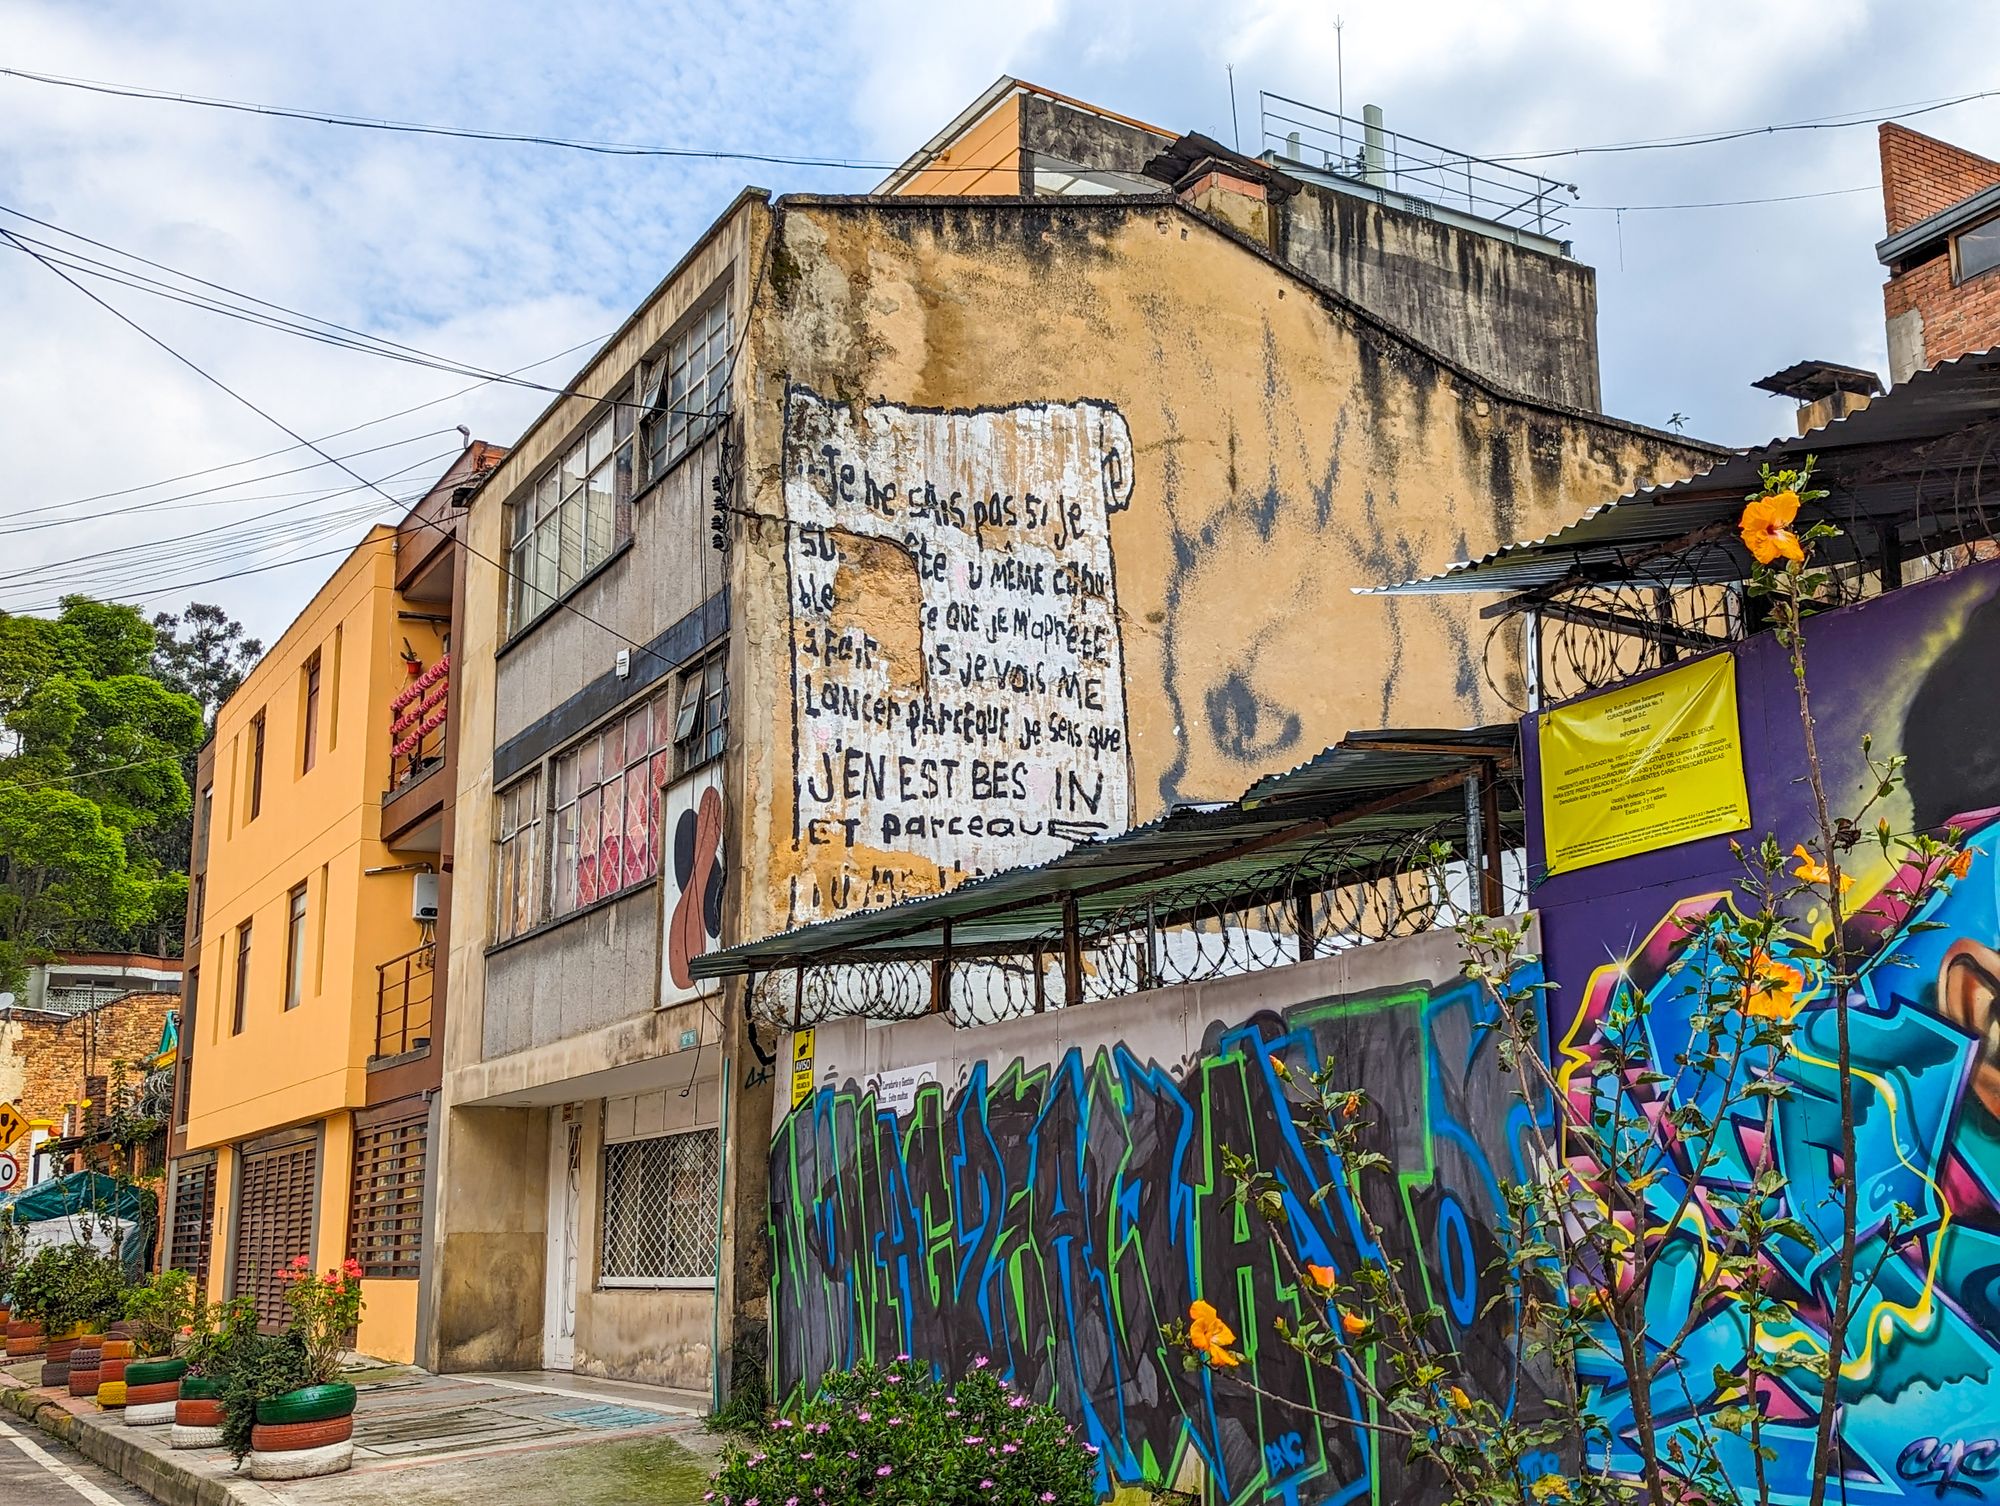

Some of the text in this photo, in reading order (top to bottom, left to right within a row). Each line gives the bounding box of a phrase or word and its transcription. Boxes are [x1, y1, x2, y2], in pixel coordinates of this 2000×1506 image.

[973, 492, 1018, 552] pas
[1057, 665, 1105, 711] ME
[899, 756, 960, 801] EST
[796, 1060, 810, 1070] AVISO
